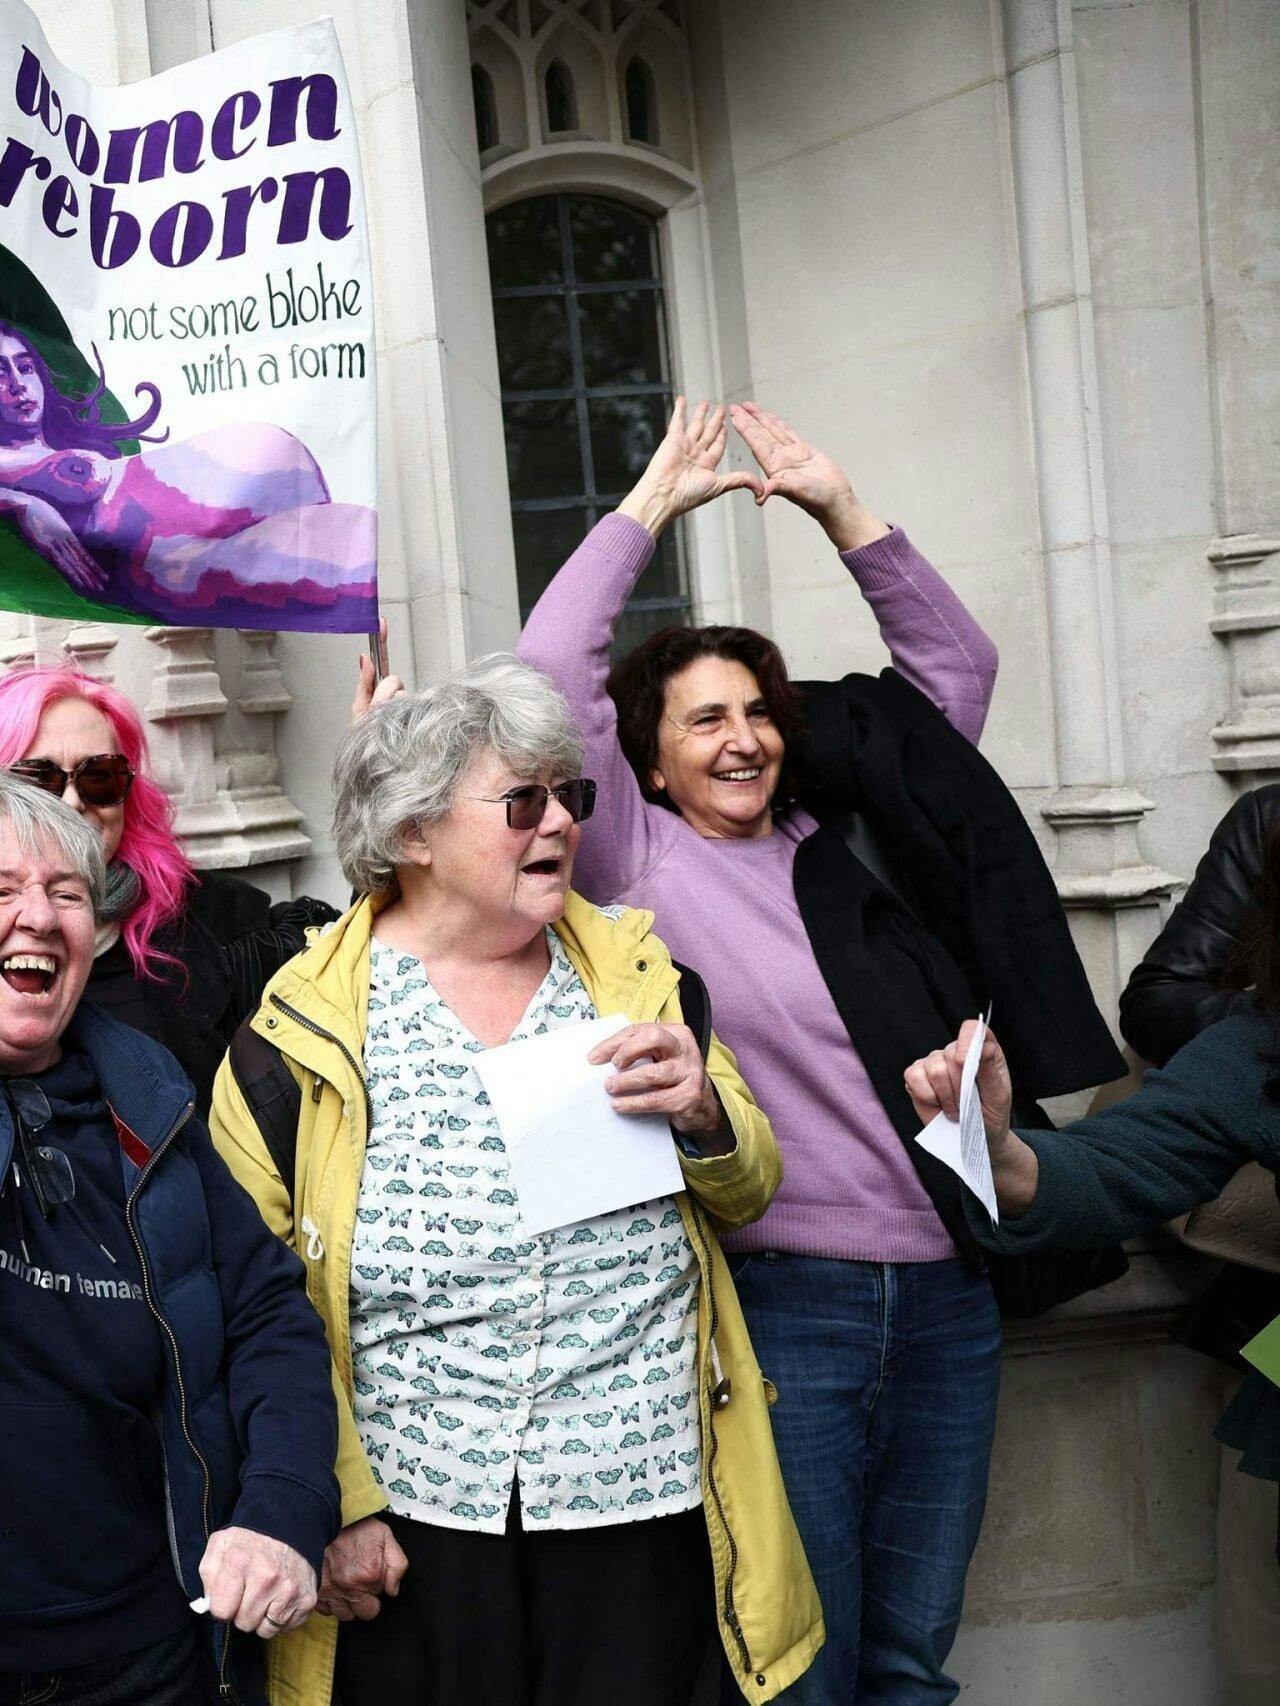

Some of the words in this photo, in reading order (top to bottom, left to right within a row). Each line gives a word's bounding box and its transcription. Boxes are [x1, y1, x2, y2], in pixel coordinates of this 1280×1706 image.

[15, 44, 342, 184] women
[89, 166, 354, 270] born
[109, 298, 165, 341] not
[170, 291, 259, 338] some
[265, 263, 362, 331] bloke
[182, 344, 248, 396] with
[257, 350, 280, 387] a
[291, 340, 366, 381] form
[76, 1272, 144, 1301] female
